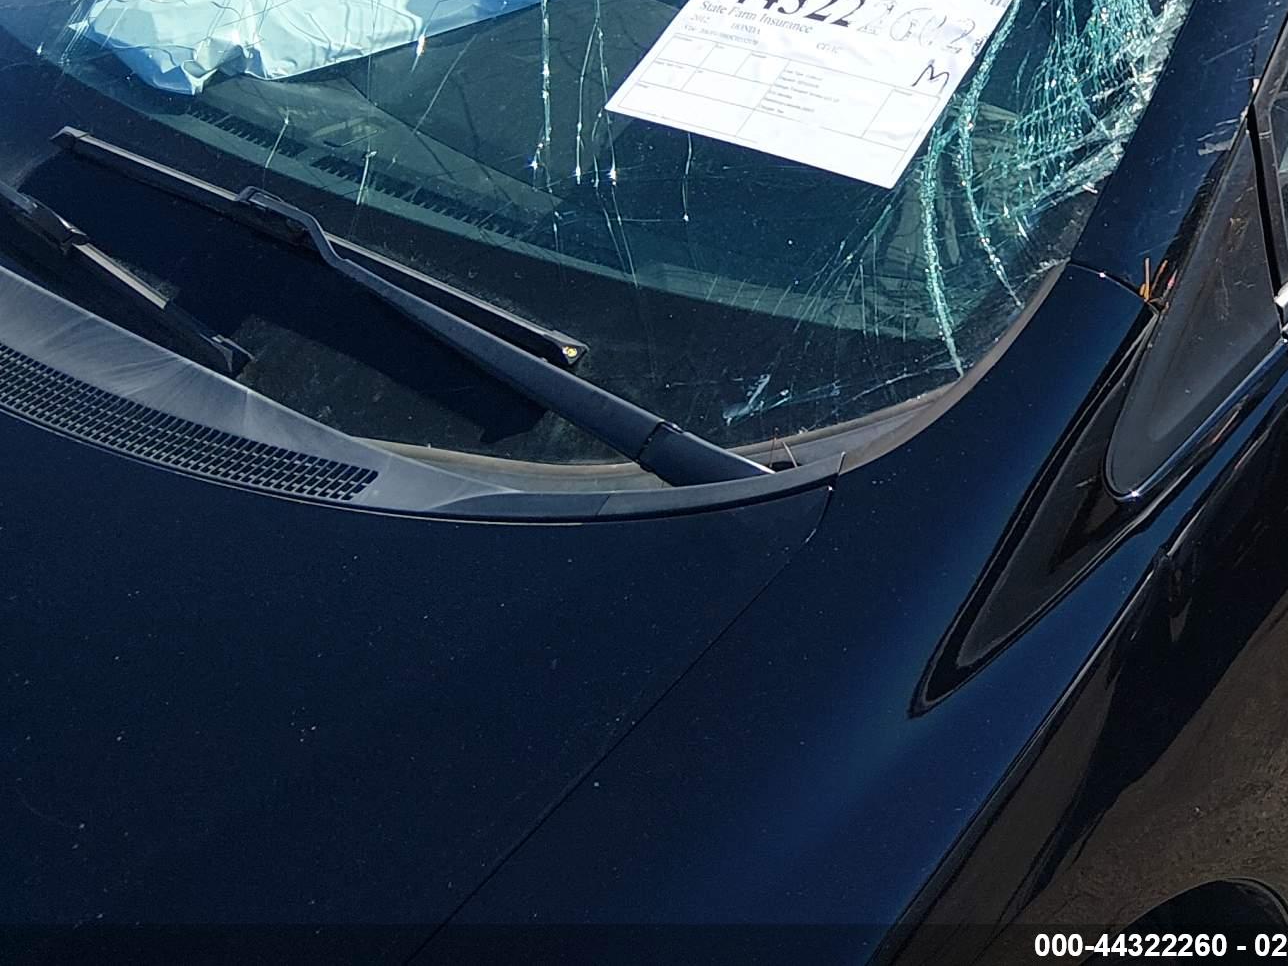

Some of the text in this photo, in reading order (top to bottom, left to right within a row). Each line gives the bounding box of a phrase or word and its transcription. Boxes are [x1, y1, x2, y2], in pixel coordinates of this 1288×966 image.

[699, 0, 728, 16] State
[727, 5, 758, 22] Farm
[759, 13, 814, 35] Insurance
